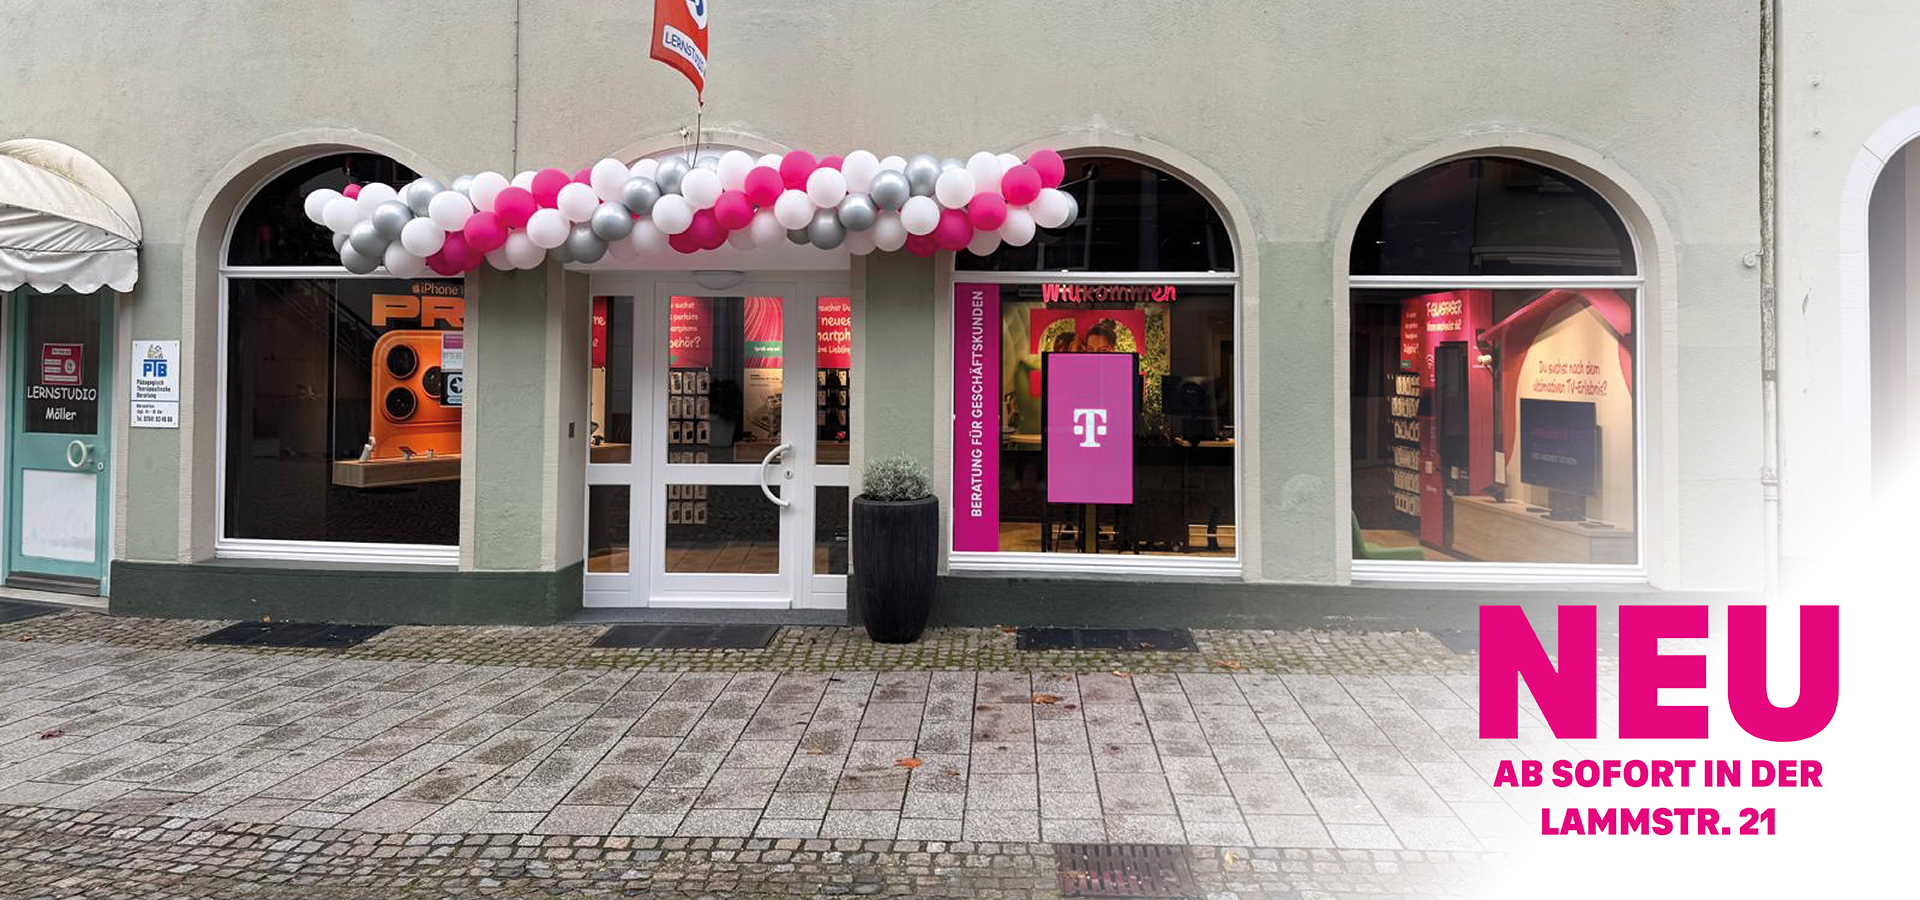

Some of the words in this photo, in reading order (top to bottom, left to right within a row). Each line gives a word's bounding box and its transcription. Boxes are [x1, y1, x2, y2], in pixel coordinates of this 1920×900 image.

[421, 282, 458, 294] iPhone
[1042, 284, 1177, 303] Willkommen
[970, 290, 984, 419] GESCHÄFTSKUNDEN
[143, 359, 167, 377] PTB
[1538, 360, 1547, 374] Du
[1569, 361, 1584, 374] nach
[1586, 362, 1600, 375] dem
[27, 386, 97, 401] LERNSTUDIO
[45, 407, 77, 421] Möller
[969, 421, 983, 446] FÜR
[1072, 408, 1107, 447] T
[971, 449, 983, 517] BERATUNG
